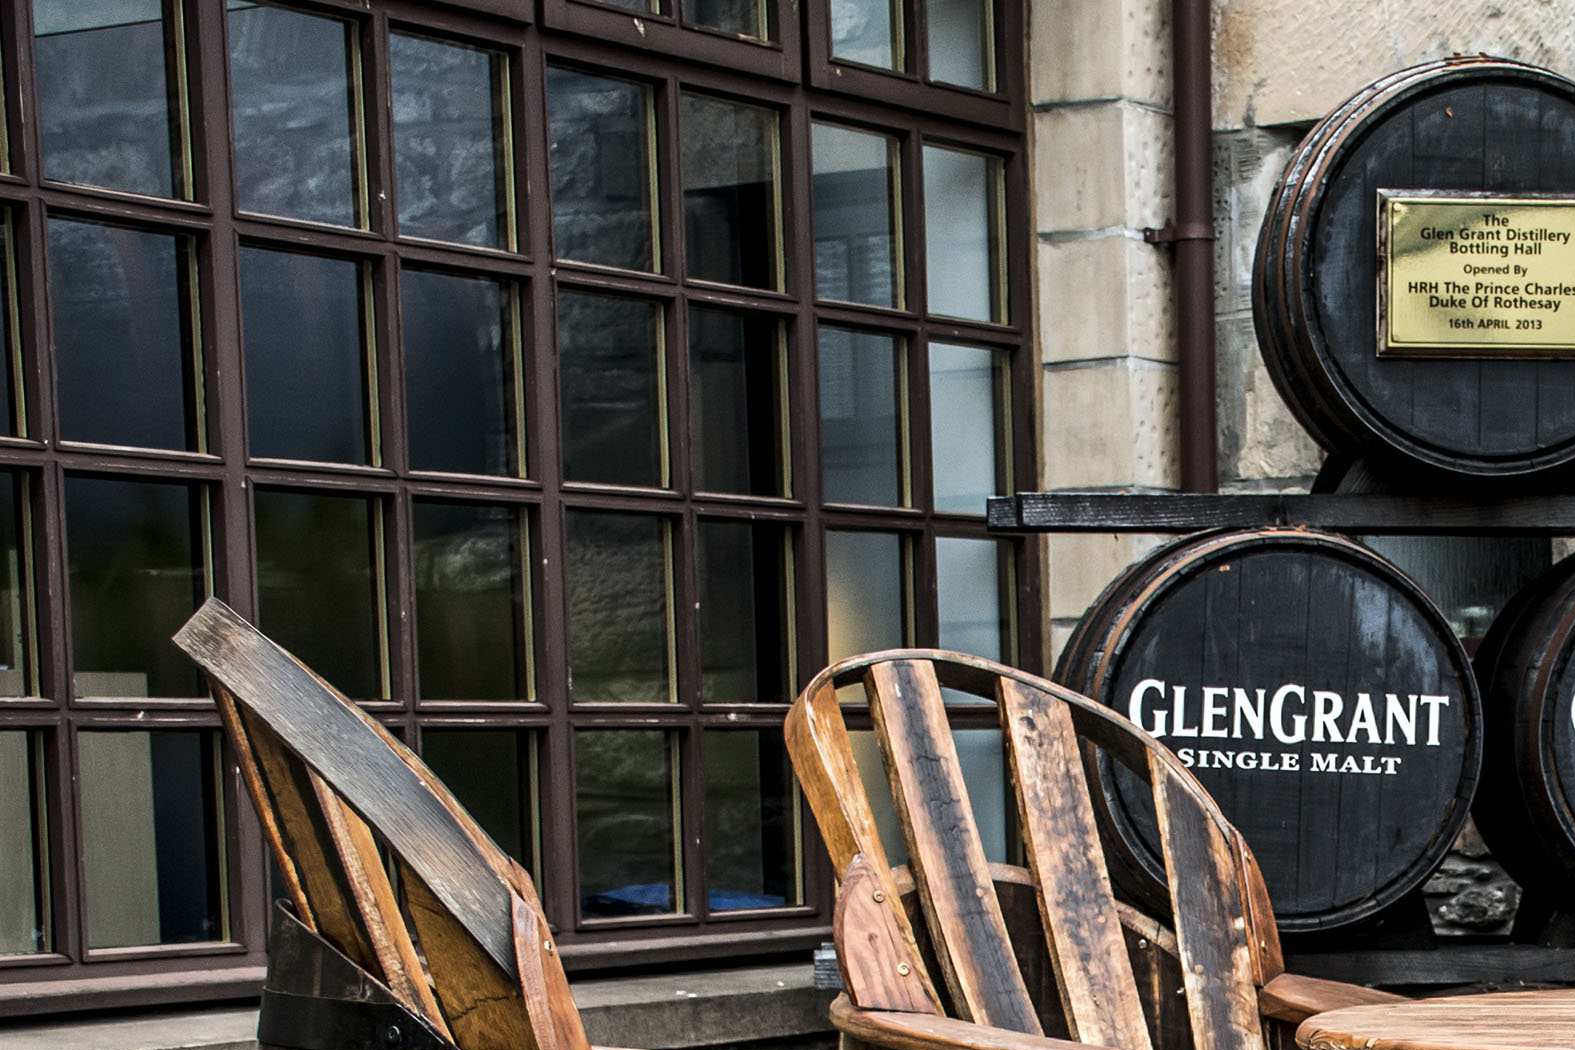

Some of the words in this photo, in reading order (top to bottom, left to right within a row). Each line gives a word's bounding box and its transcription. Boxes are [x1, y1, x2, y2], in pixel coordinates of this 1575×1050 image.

[1483, 214, 1509, 227] The
[1420, 227, 1454, 241] Glen
[1459, 228, 1501, 241] Grant
[1506, 229, 1571, 245] Distillery
[1450, 242, 1509, 258] Bottling
[1514, 243, 1542, 255] Hall
[1463, 264, 1510, 277] Opened
[1513, 265, 1528, 277] By
[1408, 282, 1439, 294] HRH
[1444, 282, 1470, 295] The
[1475, 282, 1519, 295] Prince
[1429, 296, 1467, 309] Duke
[1471, 296, 1489, 309] Of
[1494, 297, 1561, 312] Rothesay
[1448, 319, 1474, 329] 16th
[1477, 319, 1511, 329] APRIL
[1515, 320, 1543, 330] 2013
[1177, 748, 1301, 772] SINGLE
[1309, 752, 1402, 775] MALT
